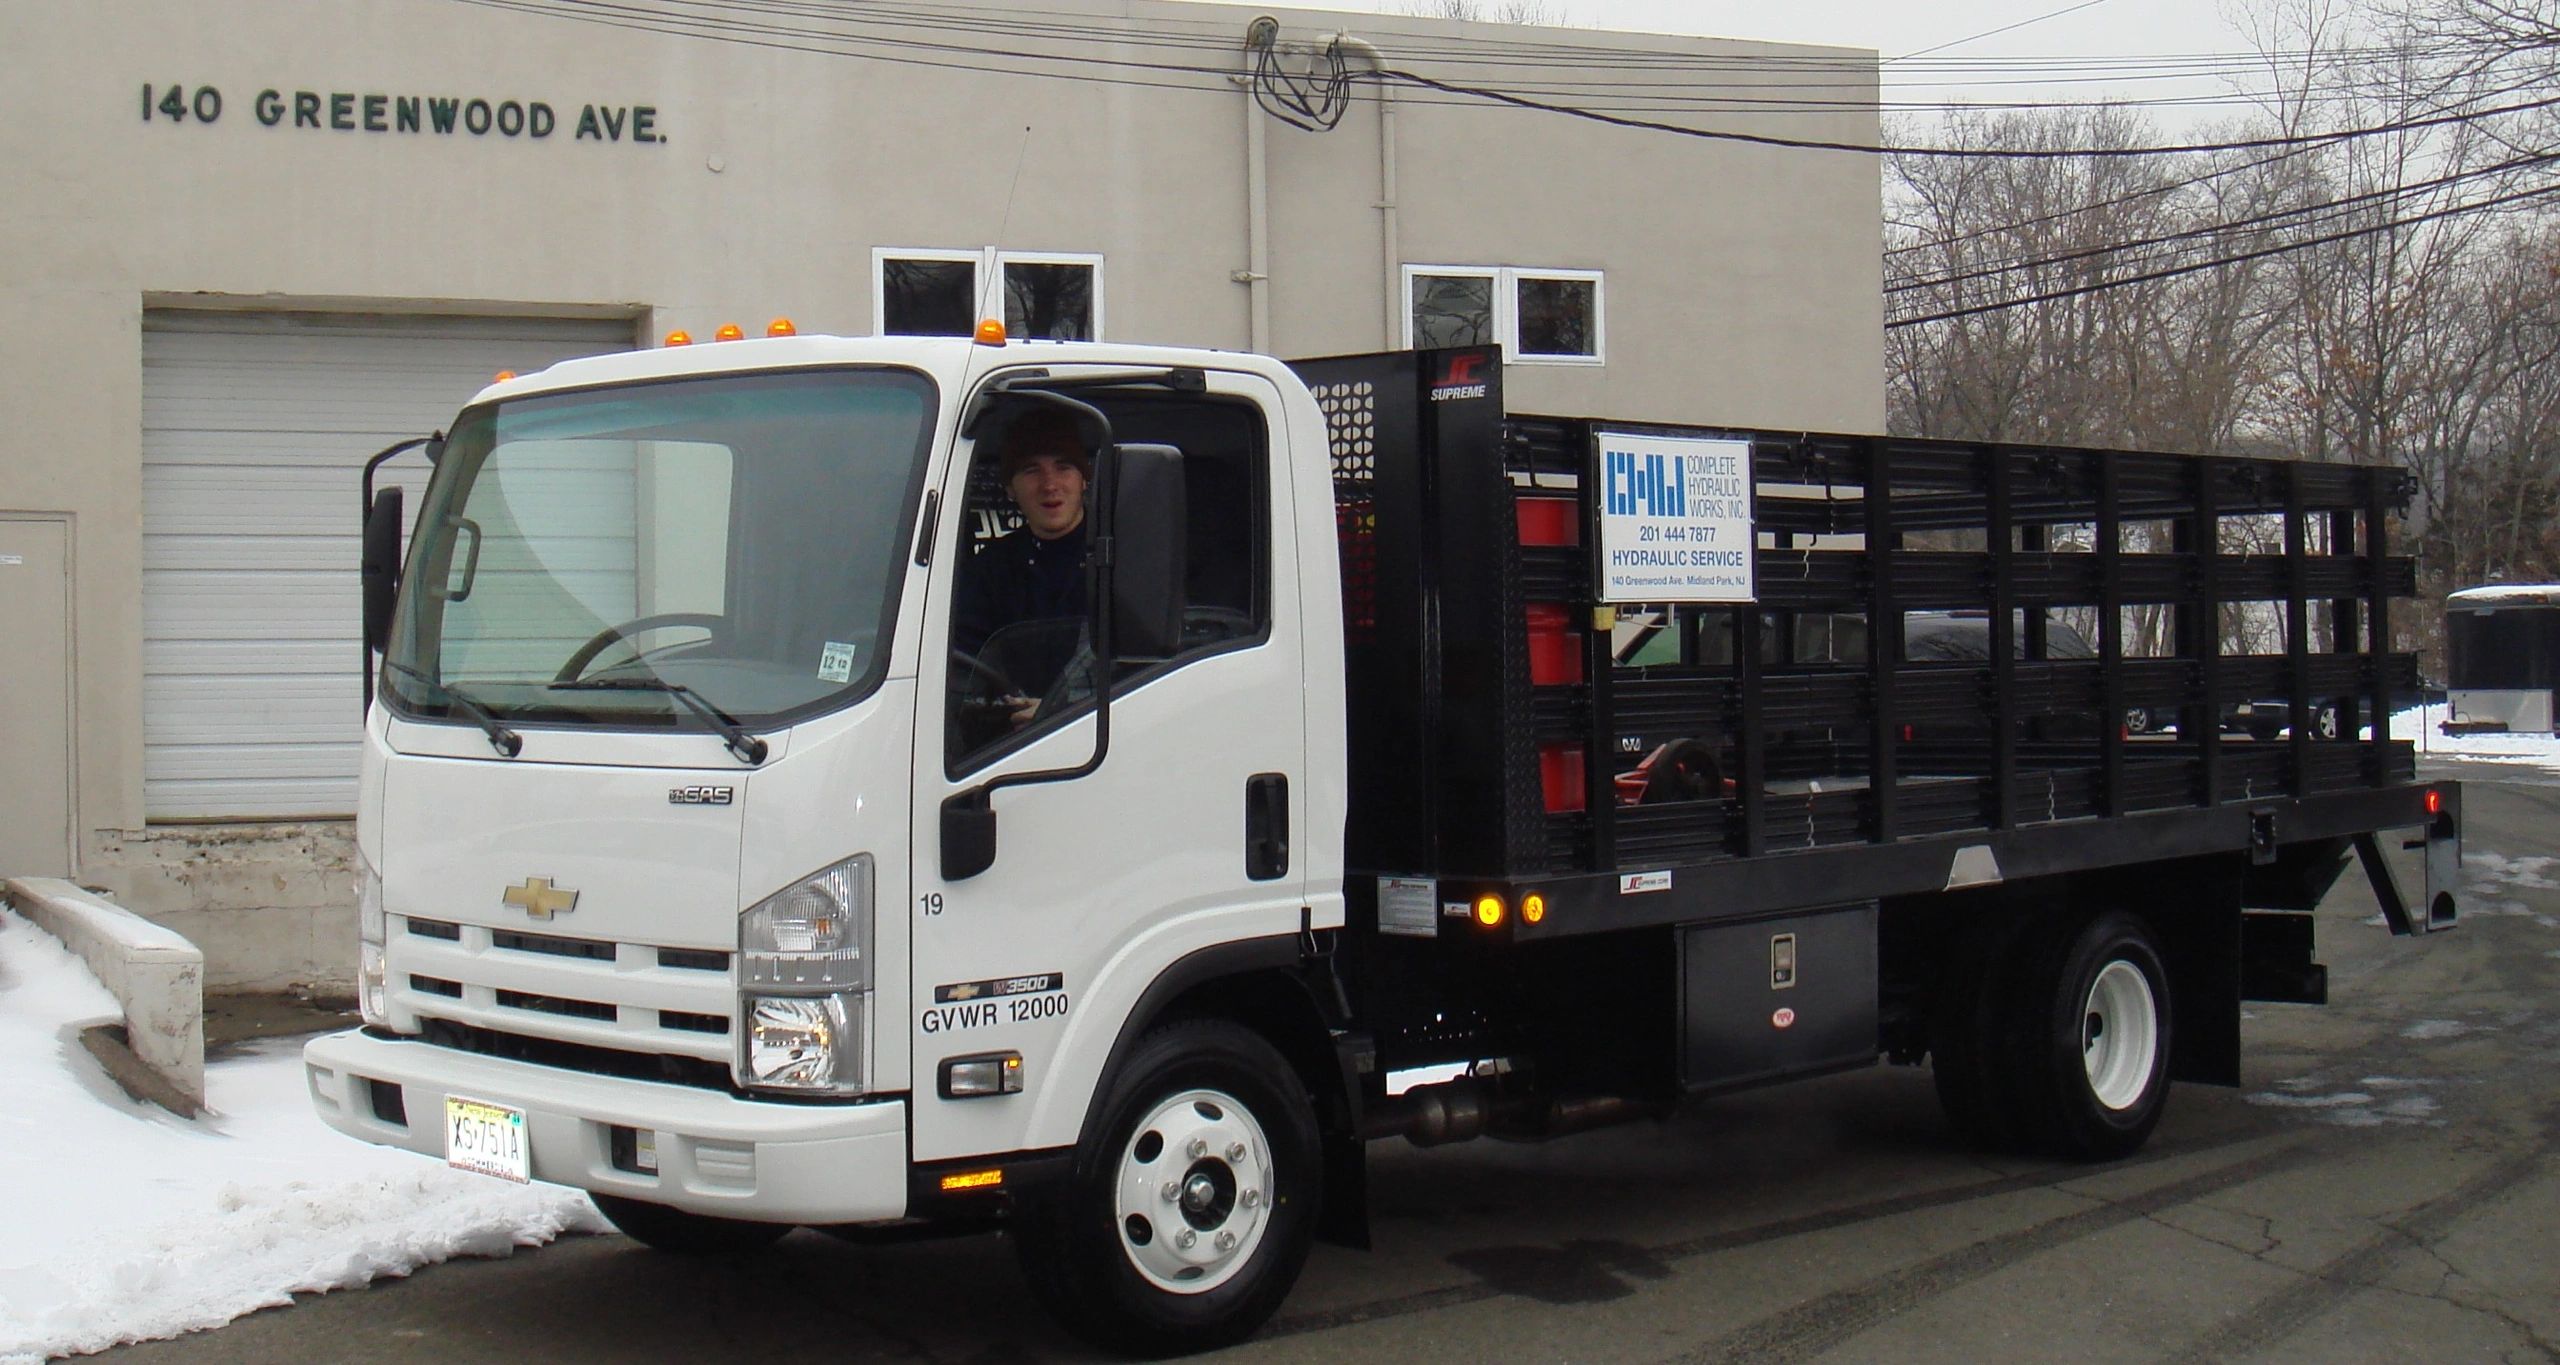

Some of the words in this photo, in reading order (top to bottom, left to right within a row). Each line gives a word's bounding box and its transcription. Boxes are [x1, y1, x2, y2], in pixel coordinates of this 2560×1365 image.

[142, 83, 222, 123] 140
[255, 88, 556, 139] GREENWOOD
[576, 104, 668, 144] AVE.
[1430, 384, 1486, 401] SUPREME
[1687, 455, 1737, 476] COMPLETE
[1688, 477, 1741, 498] HYDRAULIC
[1690, 499, 1727, 520] WORKS,
[1728, 501, 1746, 519] INC.
[1639, 525, 1660, 541] 201
[1664, 526, 1686, 542] 444
[1689, 526, 1716, 543] 7877
[1612, 550, 1687, 566] HYDRAULIC
[1691, 551, 1743, 566] SERVICE
[1612, 576, 1625, 586] 140
[1625, 576, 1668, 586] Greenwood
[1668, 576, 1684, 586] Ave.
[1687, 576, 1715, 586] Midland
[1735, 576, 1746, 586] NJ
[823, 655, 835, 669] 12
[685, 786, 732, 804] GAS
[920, 892, 944, 917] 19
[993, 976, 1049, 996] W3500
[921, 1003, 998, 1034] GVWR
[1008, 993, 1069, 1023] 12000
